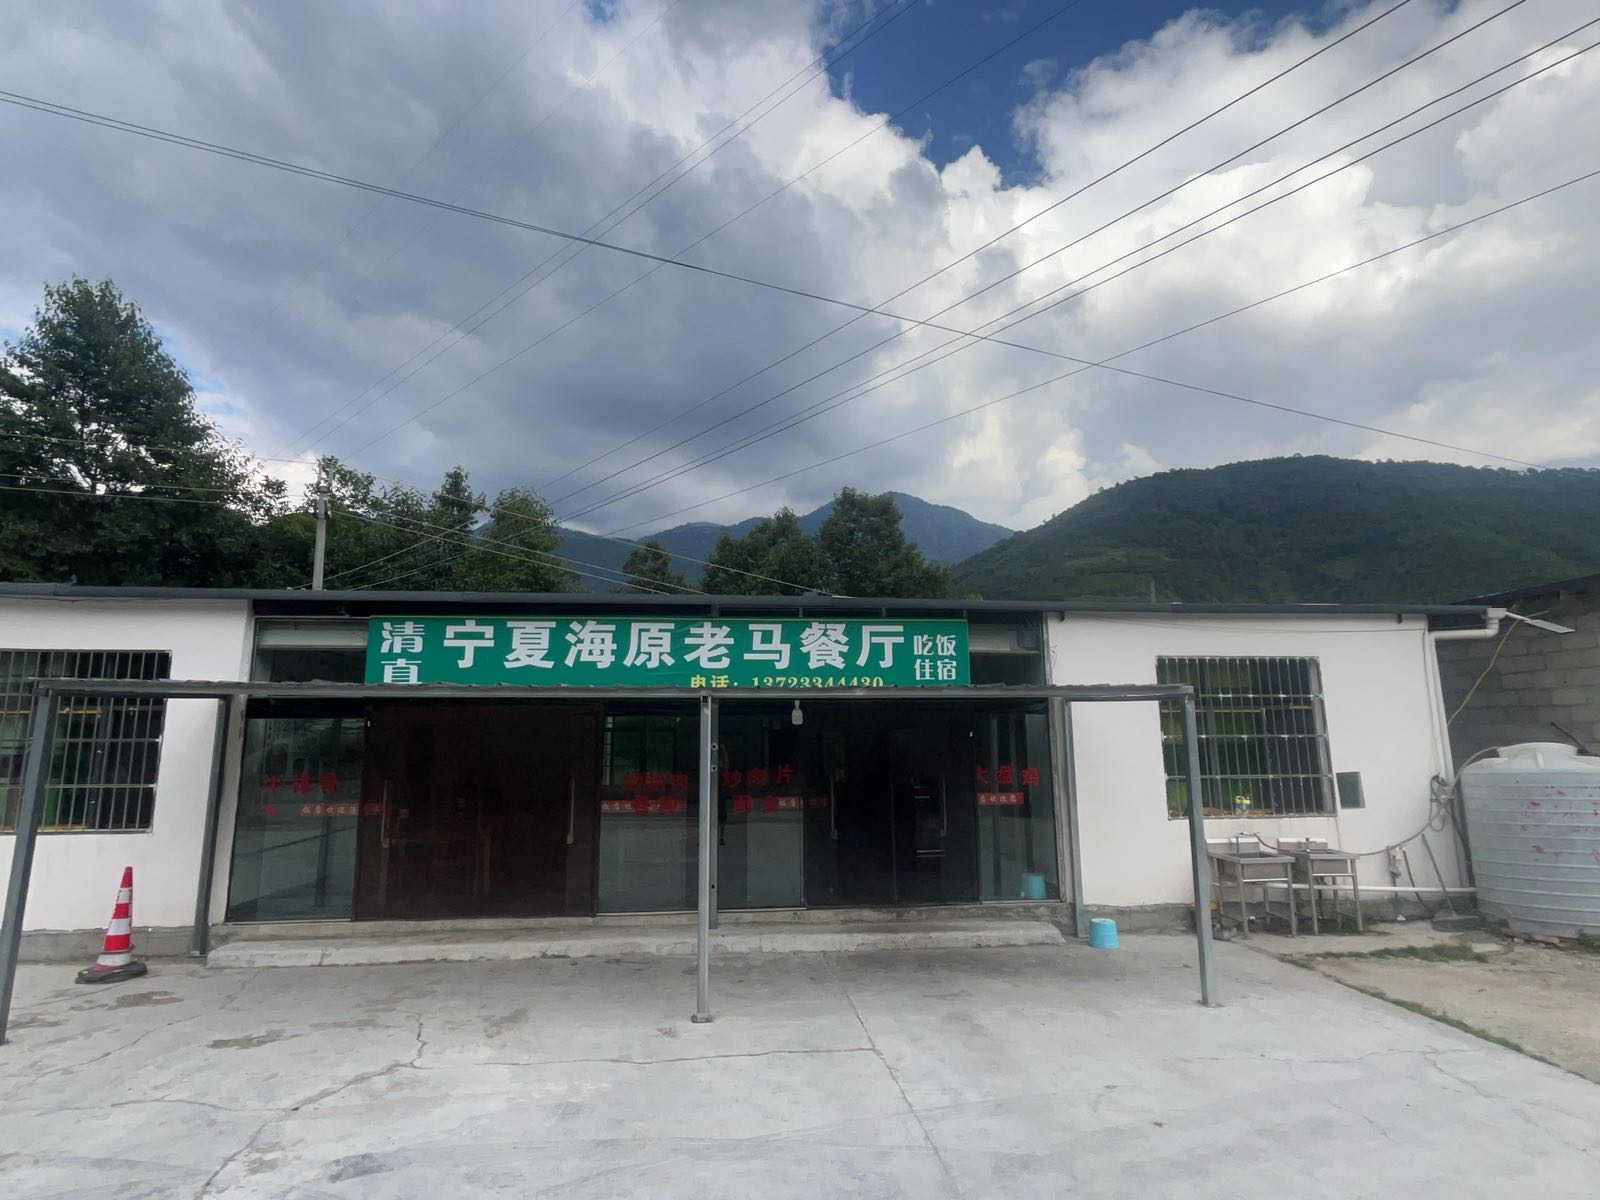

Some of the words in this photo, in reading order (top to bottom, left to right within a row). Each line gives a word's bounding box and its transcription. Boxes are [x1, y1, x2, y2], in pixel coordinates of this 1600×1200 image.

[380, 621, 425, 685] 清真
[443, 619, 905, 670] 宁夏海原老马餐厅
[913, 635, 957, 657] 吃饭
[913, 658, 957, 681] 住宿
